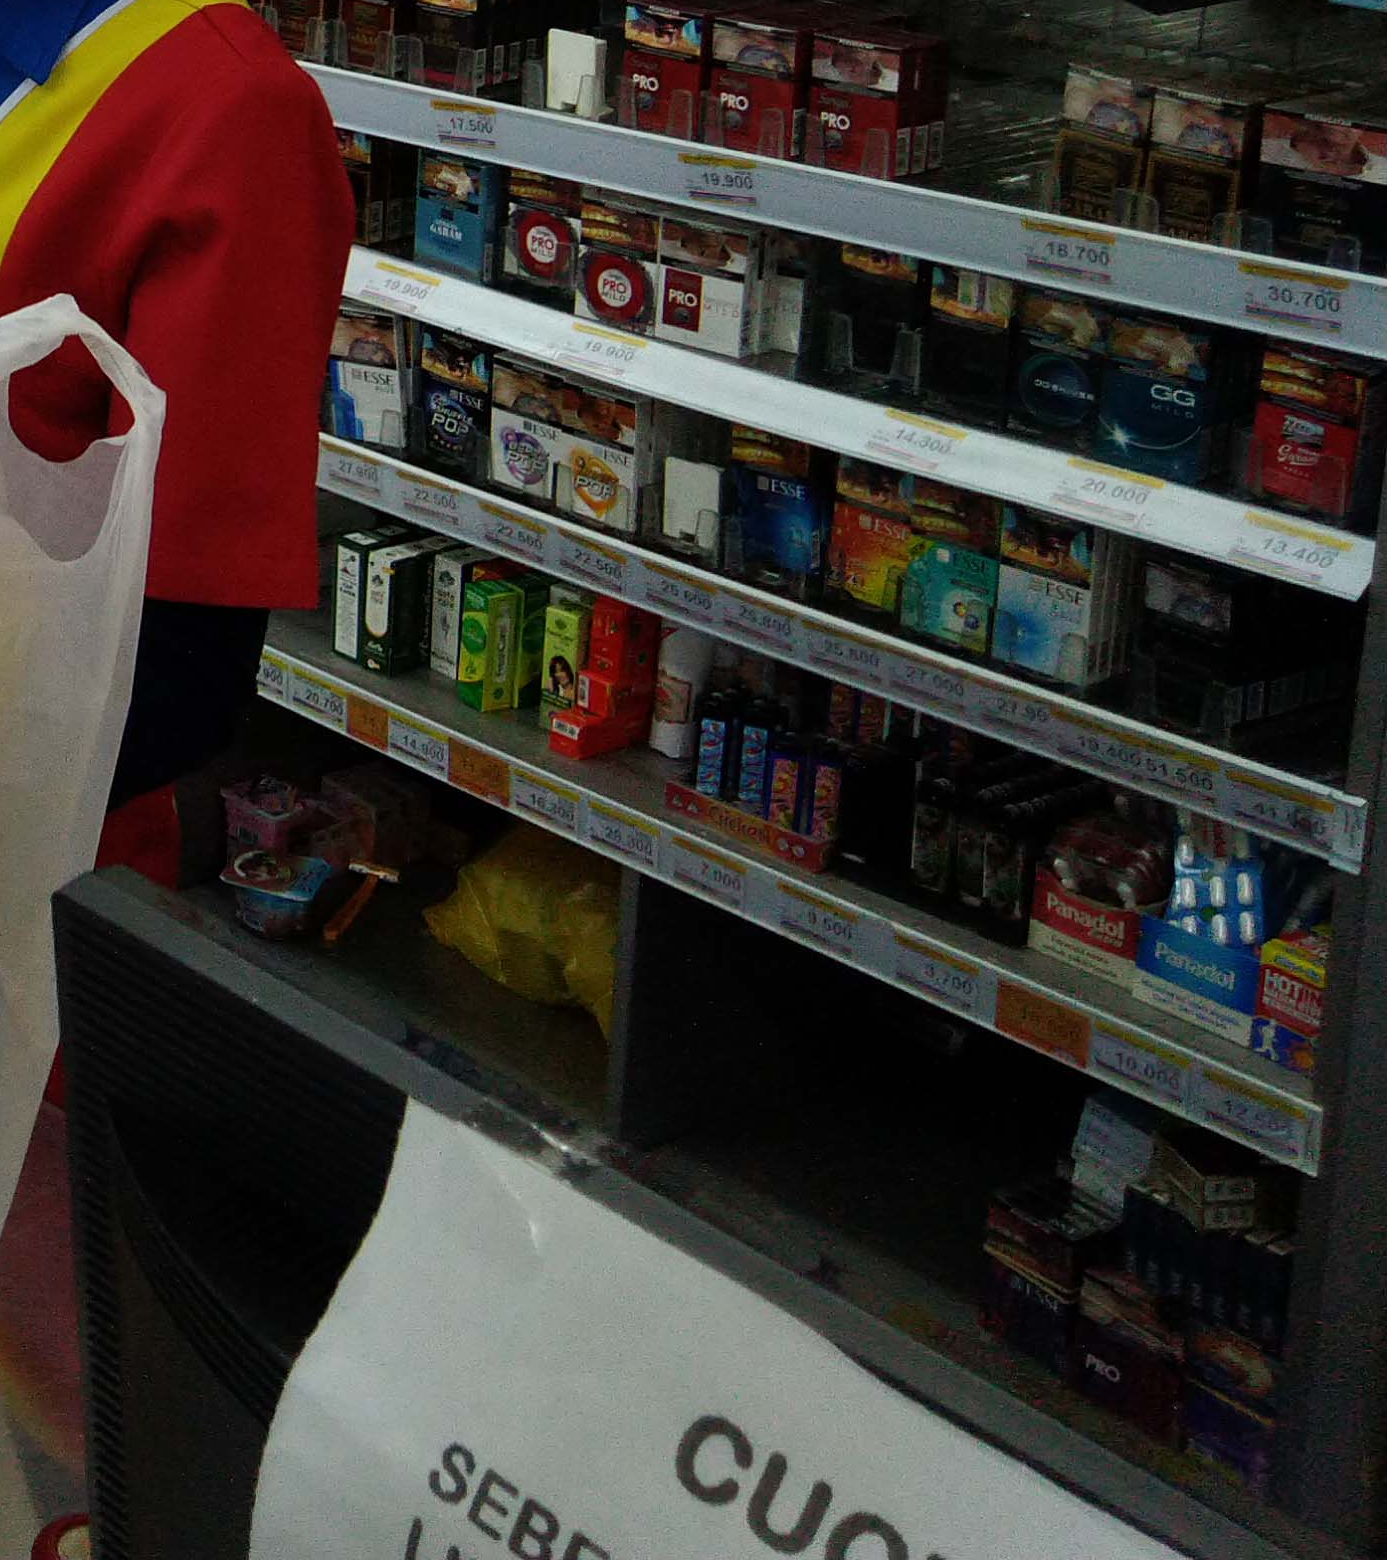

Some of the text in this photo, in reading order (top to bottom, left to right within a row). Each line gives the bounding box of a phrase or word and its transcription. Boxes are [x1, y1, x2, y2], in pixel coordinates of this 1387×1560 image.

[631, 72, 660, 92] PRO
[720, 91, 750, 112] PRO
[448, 117, 494, 135] 17.500
[820, 110, 851, 132] PRO
[701, 172, 755, 191] 19.900
[530, 234, 555, 251] PRO
[601, 278, 627, 294] PRO
[668, 288, 699, 307] PRO
[1266, 283, 1342, 314] 30.700
[363, 372, 395, 385] ESSE
[1149, 383, 1197, 408] GG
[430, 414, 470, 436] POP
[769, 474, 807, 500] ESSE
[1080, 476, 1150, 506] 20.000
[1043, 577, 1084, 608] ESSE
[1045, 891, 1127, 940] Panadol
[1154, 940, 1236, 992] Panadol
[1083, 1352, 1121, 1384] PRO
